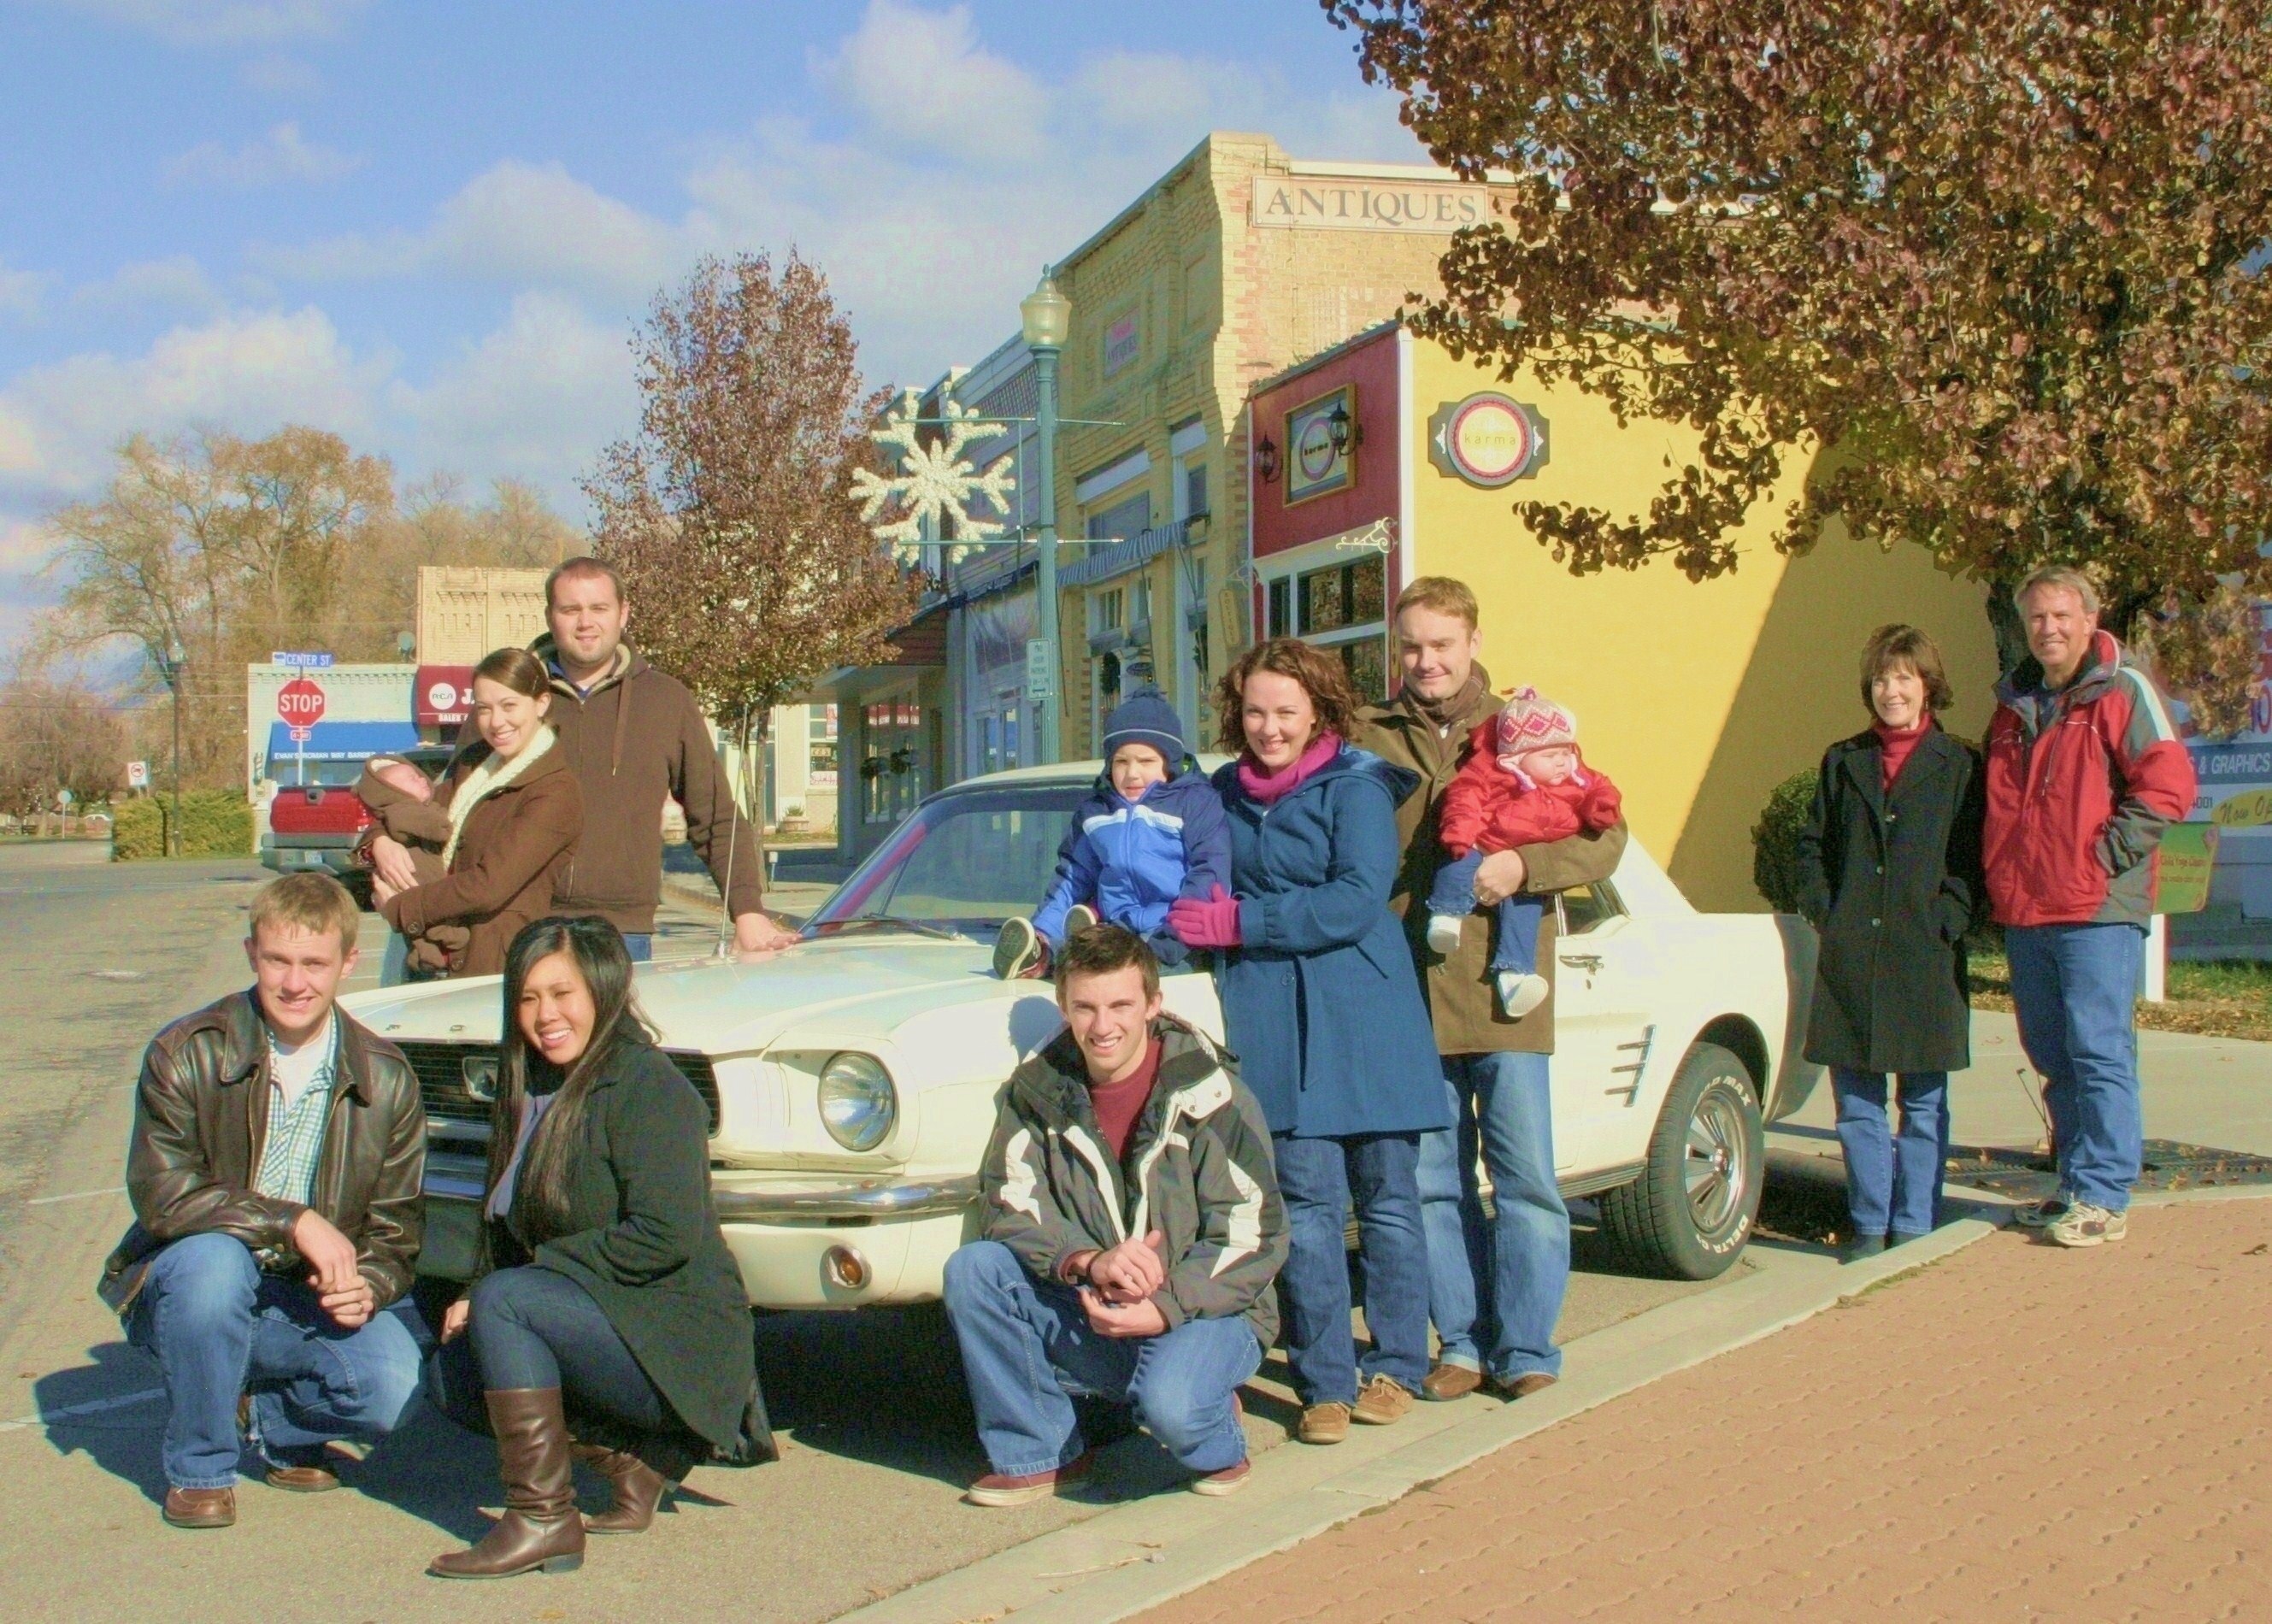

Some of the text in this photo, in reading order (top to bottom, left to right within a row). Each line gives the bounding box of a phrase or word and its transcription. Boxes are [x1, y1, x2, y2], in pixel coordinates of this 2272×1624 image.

[1265, 186, 1477, 227] ANTIQUES
[1464, 432, 1516, 445] karma
[1304, 442, 1329, 456] karma
[285, 653, 333, 666] CENTER ST
[280, 693, 323, 713] STOP
[2210, 752, 2271, 775] GRAPHICS
